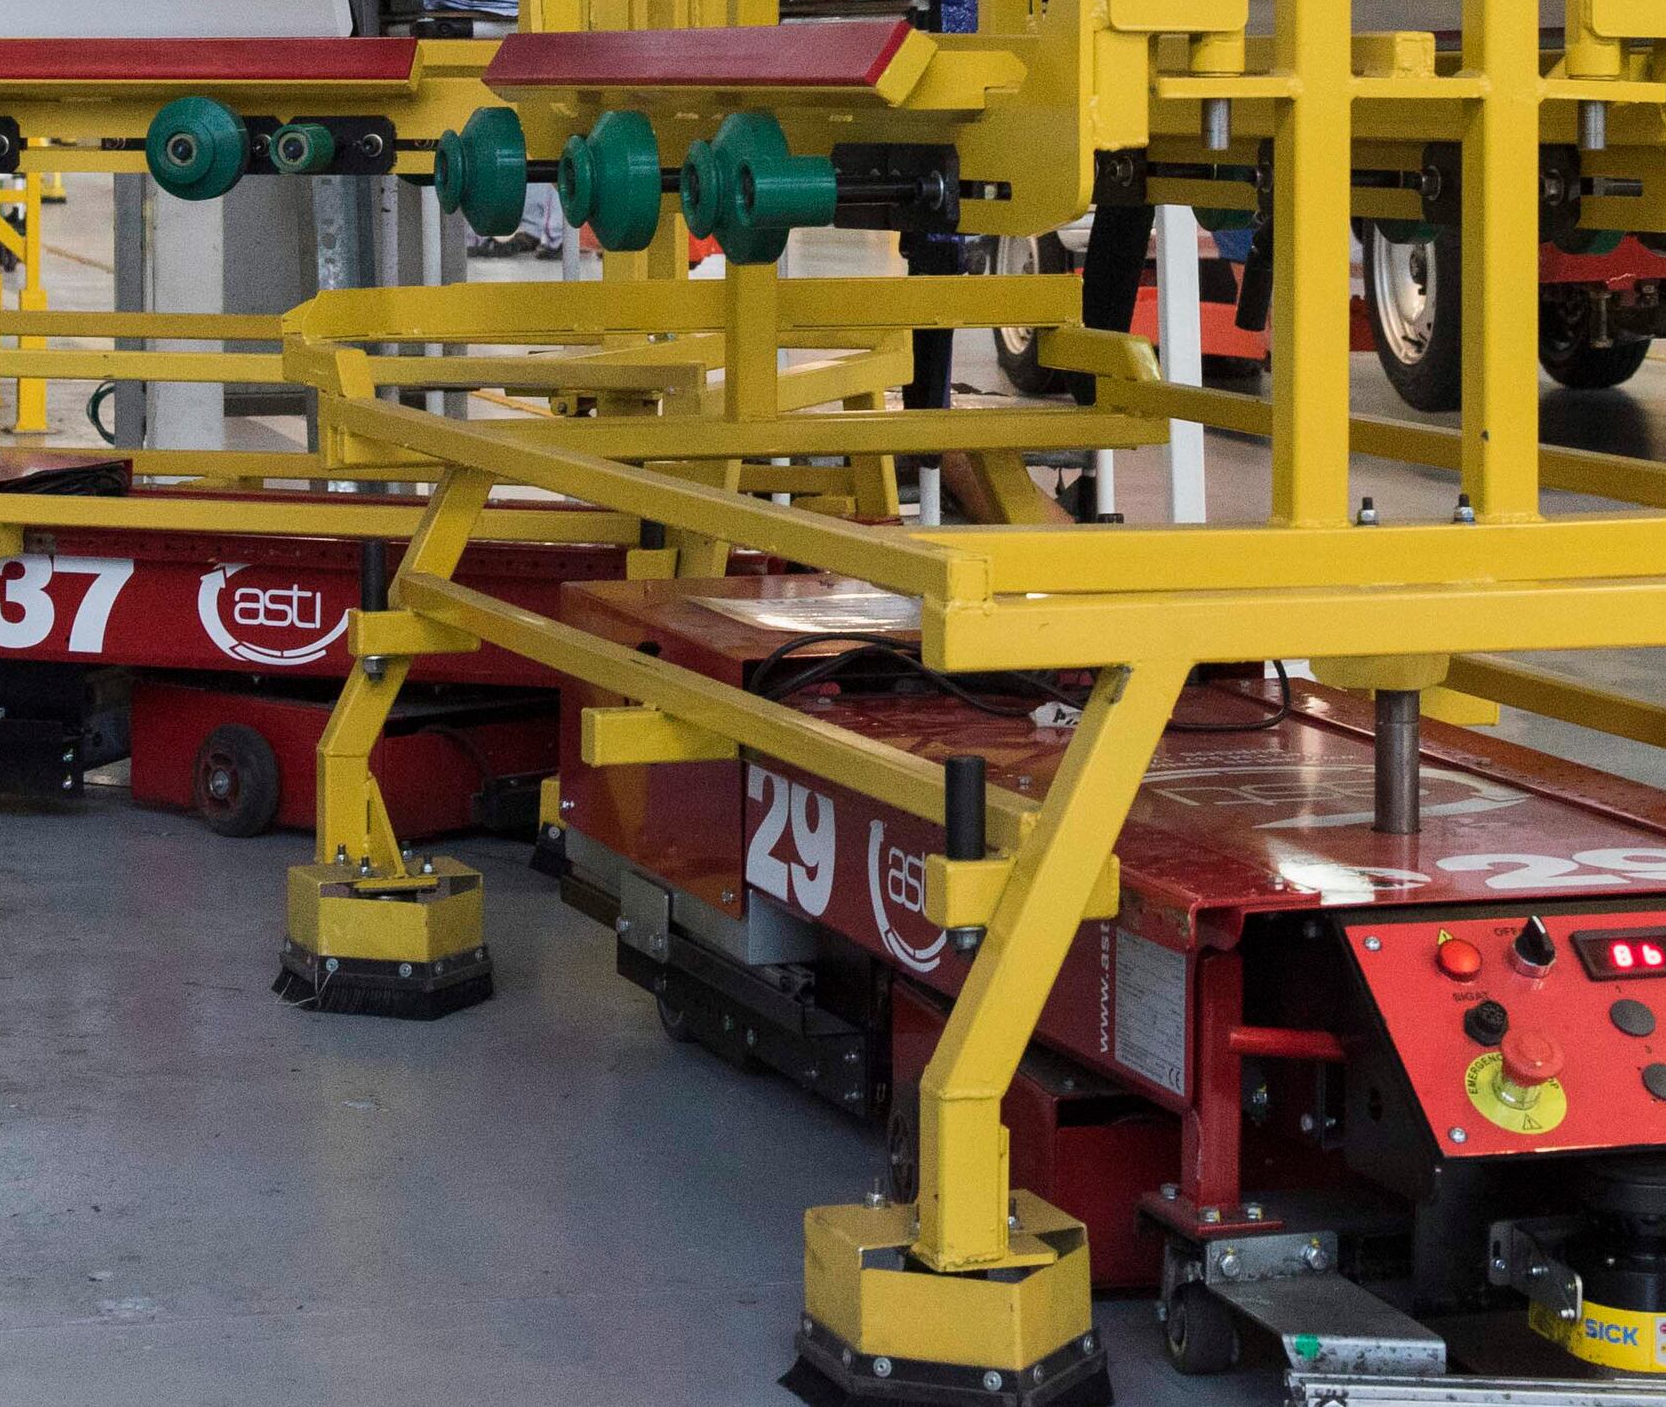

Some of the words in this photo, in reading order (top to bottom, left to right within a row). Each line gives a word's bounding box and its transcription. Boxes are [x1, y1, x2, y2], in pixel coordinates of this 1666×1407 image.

[233, 583, 322, 630] asti
[745, 764, 837, 917] 29
[888, 846, 928, 914] ast
[1100, 921, 1111, 1054] www.ast
[1466, 1052, 1504, 1095] EMERGENC
[1585, 1318, 1639, 1346] SICK
